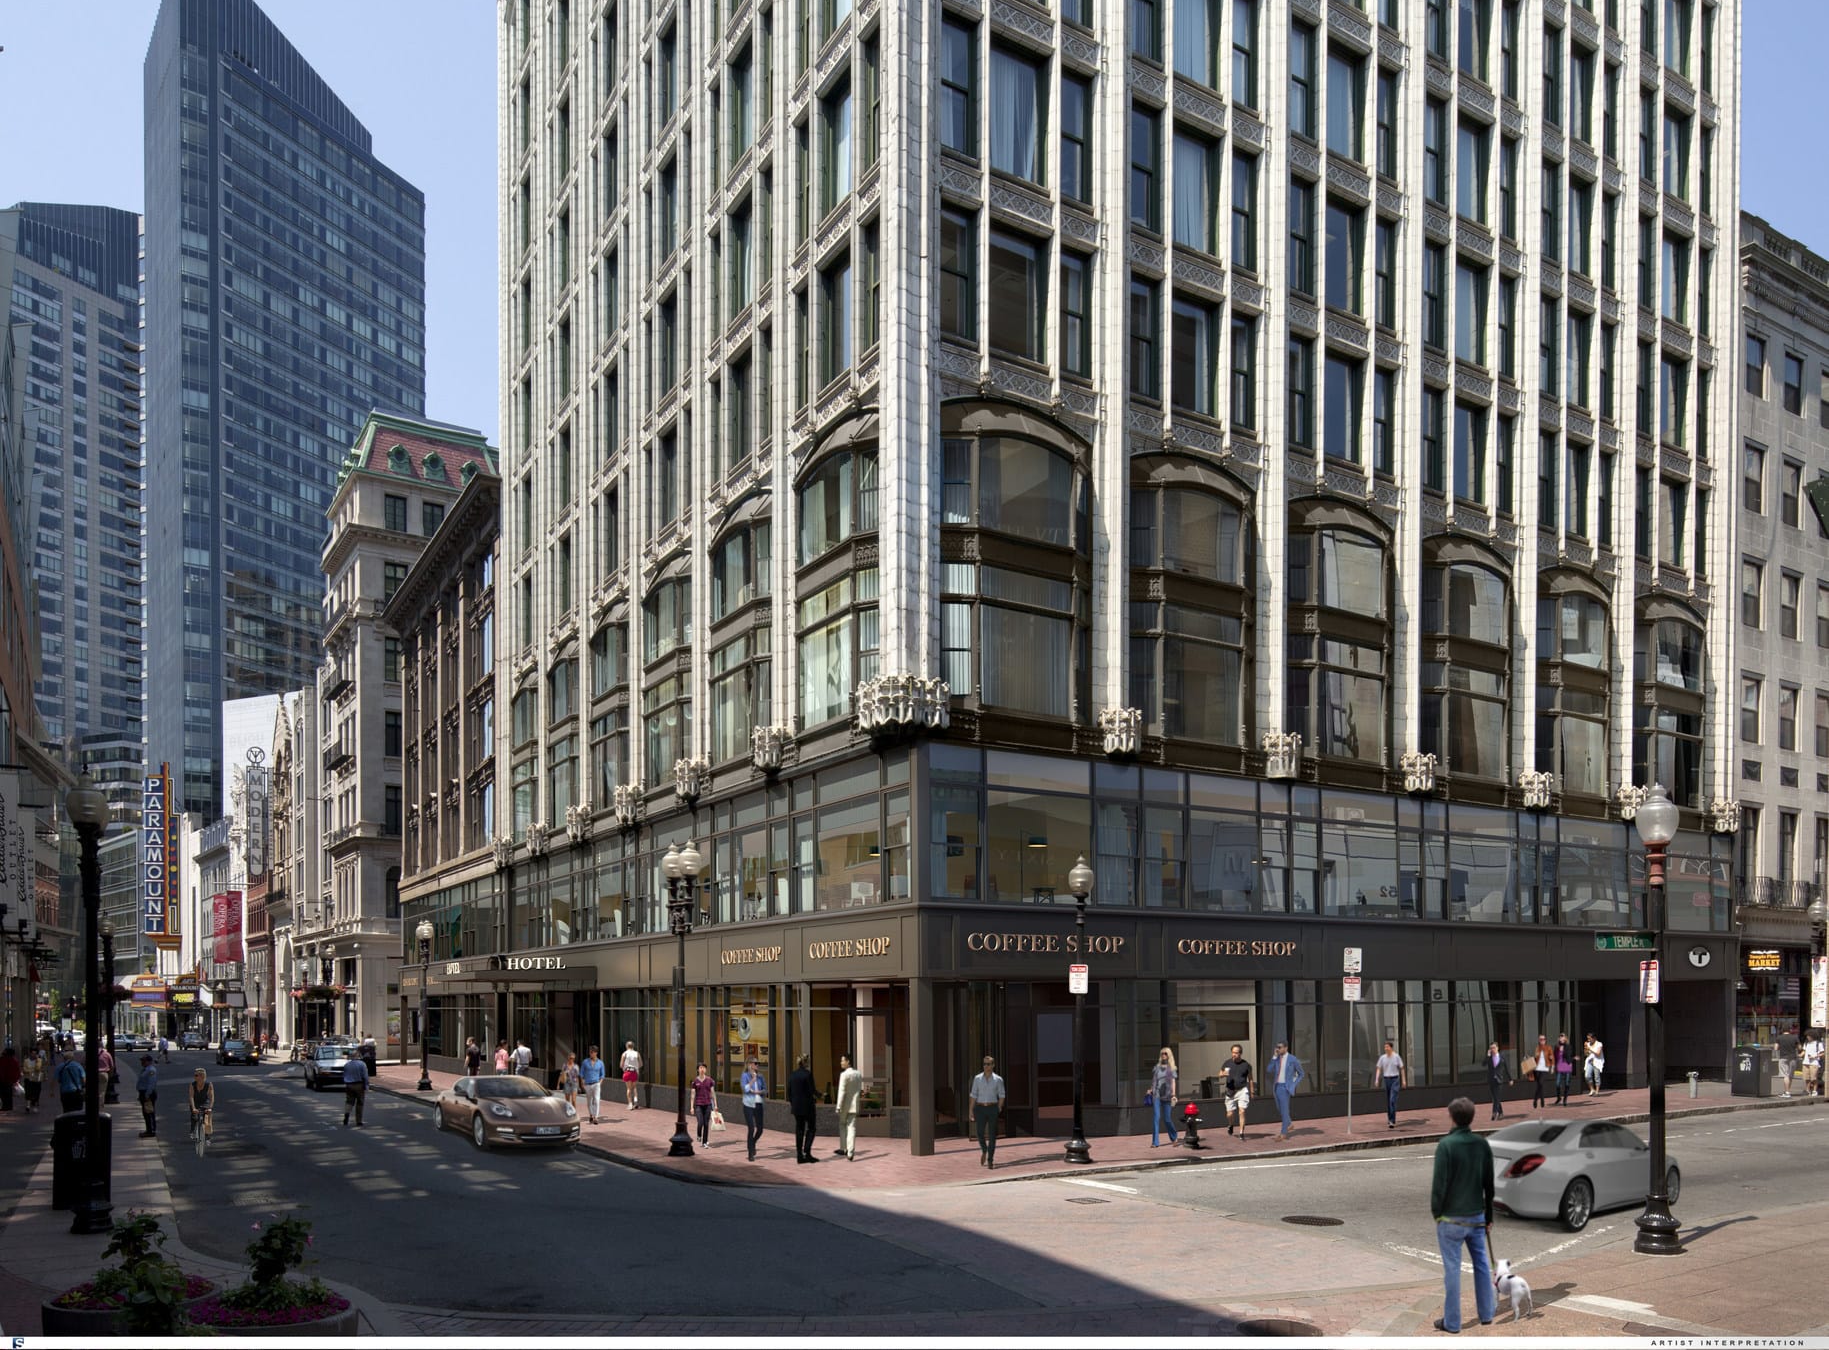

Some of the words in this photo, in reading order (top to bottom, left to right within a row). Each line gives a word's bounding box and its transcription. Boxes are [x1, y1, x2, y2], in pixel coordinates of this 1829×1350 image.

[250, 774, 263, 867] MODERN
[9, 819, 17, 880] OUTLET
[147, 778, 163, 931] PARAMOUNT
[809, 940, 853, 960] COFFEE
[855, 936, 890, 957] SHOP
[967, 932, 1060, 953] COFFEE
[1177, 938, 1248, 956] COFFEE
[1251, 940, 1297, 957] SHOP
[1612, 936, 1639, 948] TEMPLE
[507, 957, 566, 970] HOTEL
[721, 948, 754, 965] COFFEE
[755, 945, 781, 963] SHOP
[1748, 959, 1781, 967] MARKET
